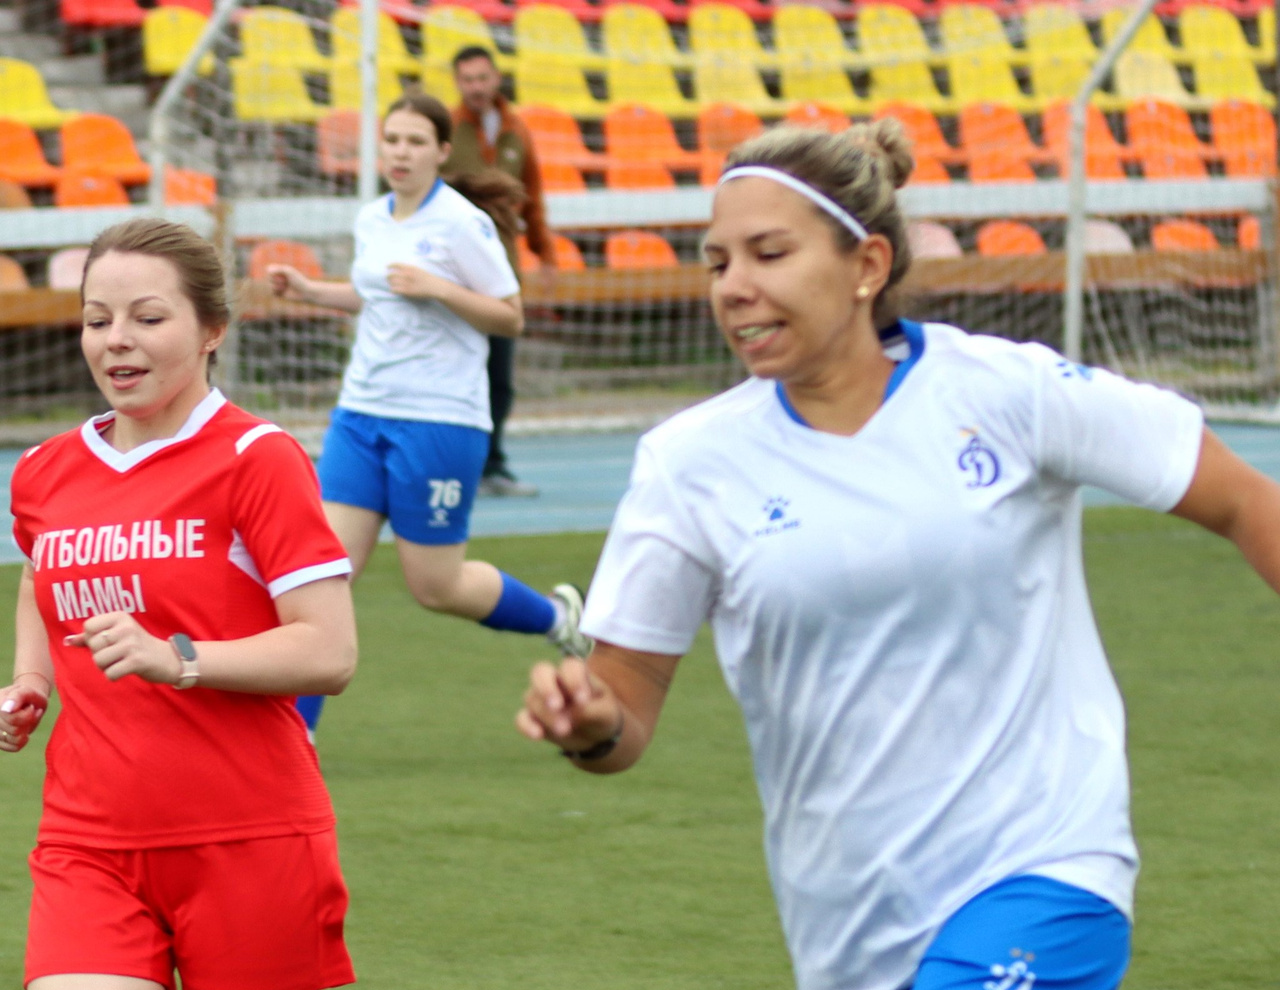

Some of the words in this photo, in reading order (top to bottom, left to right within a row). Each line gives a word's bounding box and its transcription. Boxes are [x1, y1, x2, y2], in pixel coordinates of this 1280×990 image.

[429, 479, 462, 507] 76
[32, 519, 206, 572] УТБОЛЬНЫЕ
[52, 574, 146, 622] МАМЫ
